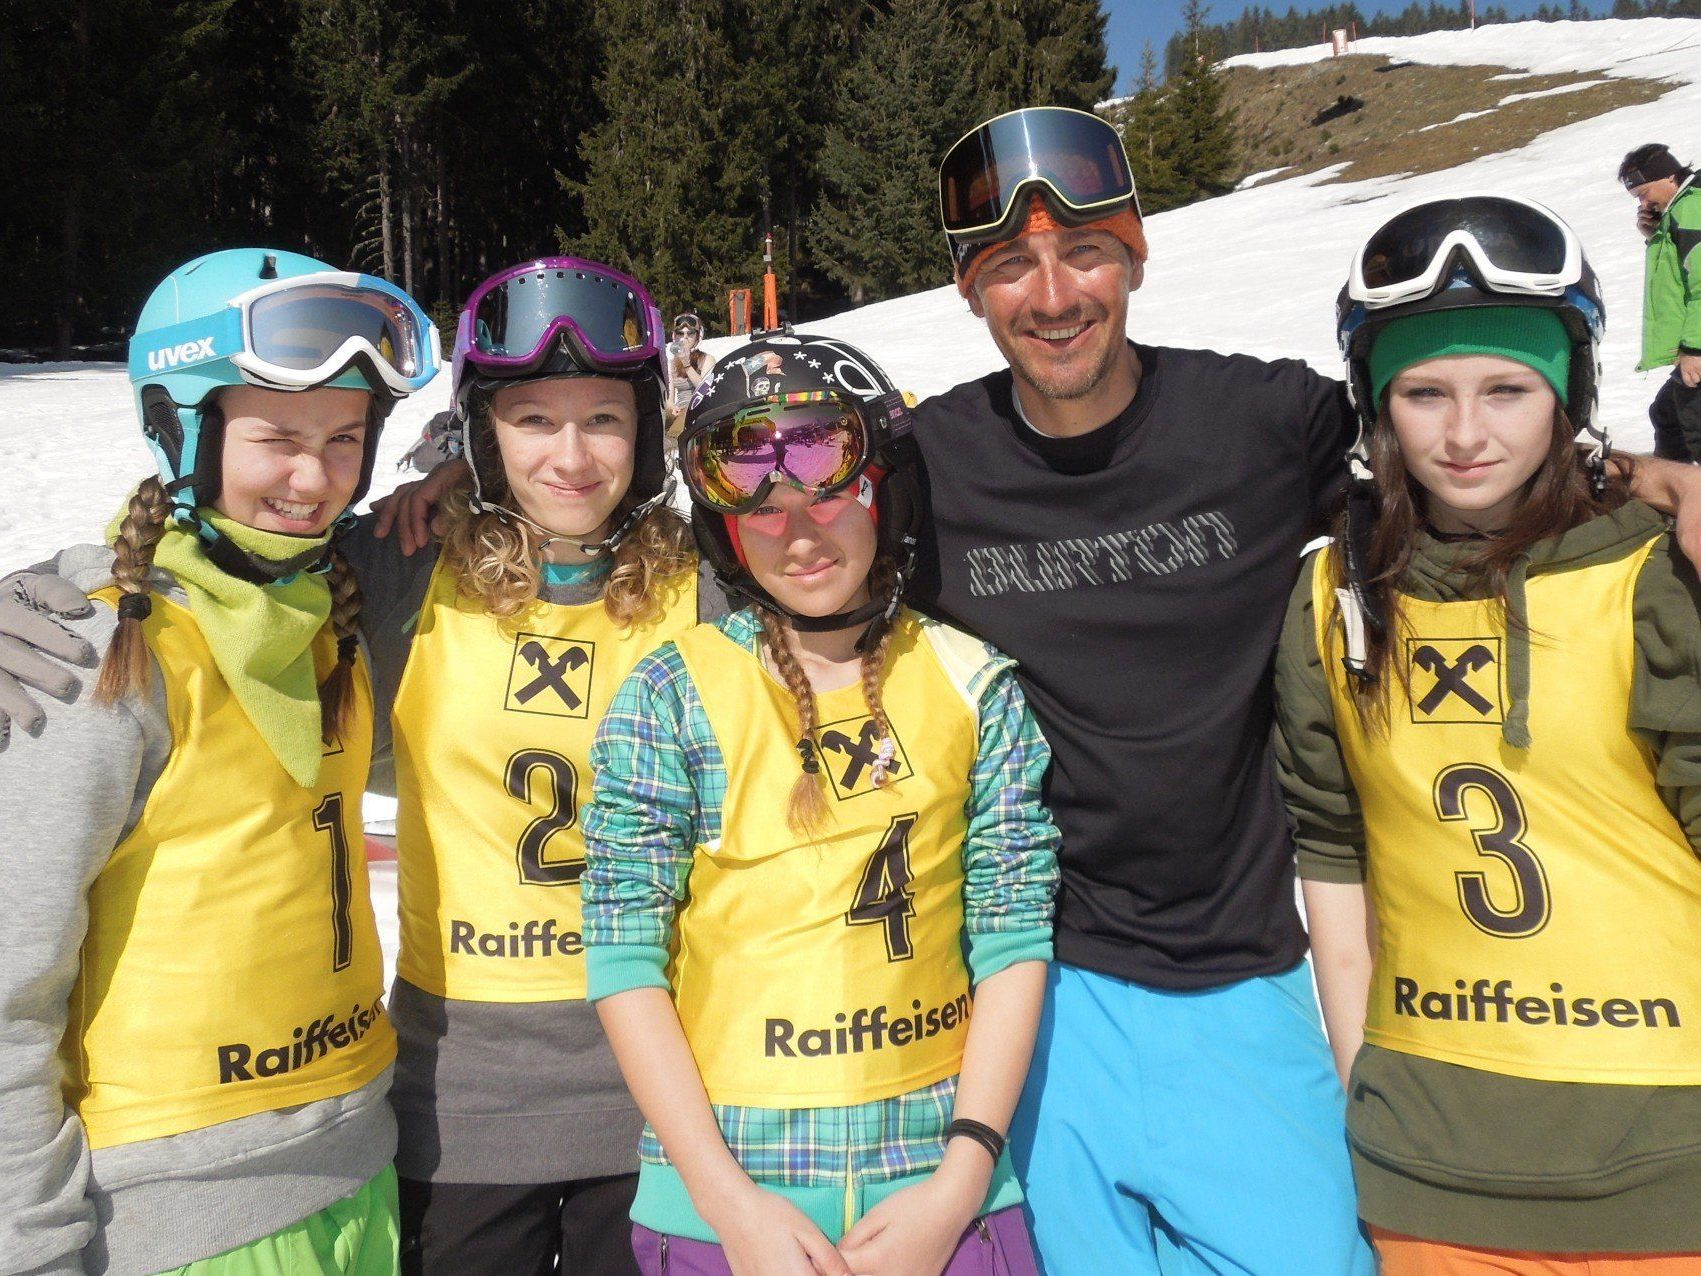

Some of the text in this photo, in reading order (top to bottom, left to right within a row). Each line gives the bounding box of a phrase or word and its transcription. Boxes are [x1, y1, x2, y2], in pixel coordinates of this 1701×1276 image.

[148, 336, 216, 371] uvex
[966, 511, 1238, 597] BURTON
[503, 748, 587, 885] 2
[1433, 762, 1552, 940] 3
[312, 792, 353, 973] 1
[845, 812, 918, 963] 4
[218, 999, 382, 1085] Raiffeisn
[764, 993, 970, 1058] Raiffeisen
[1395, 976, 1681, 1028] Raiffeisen
